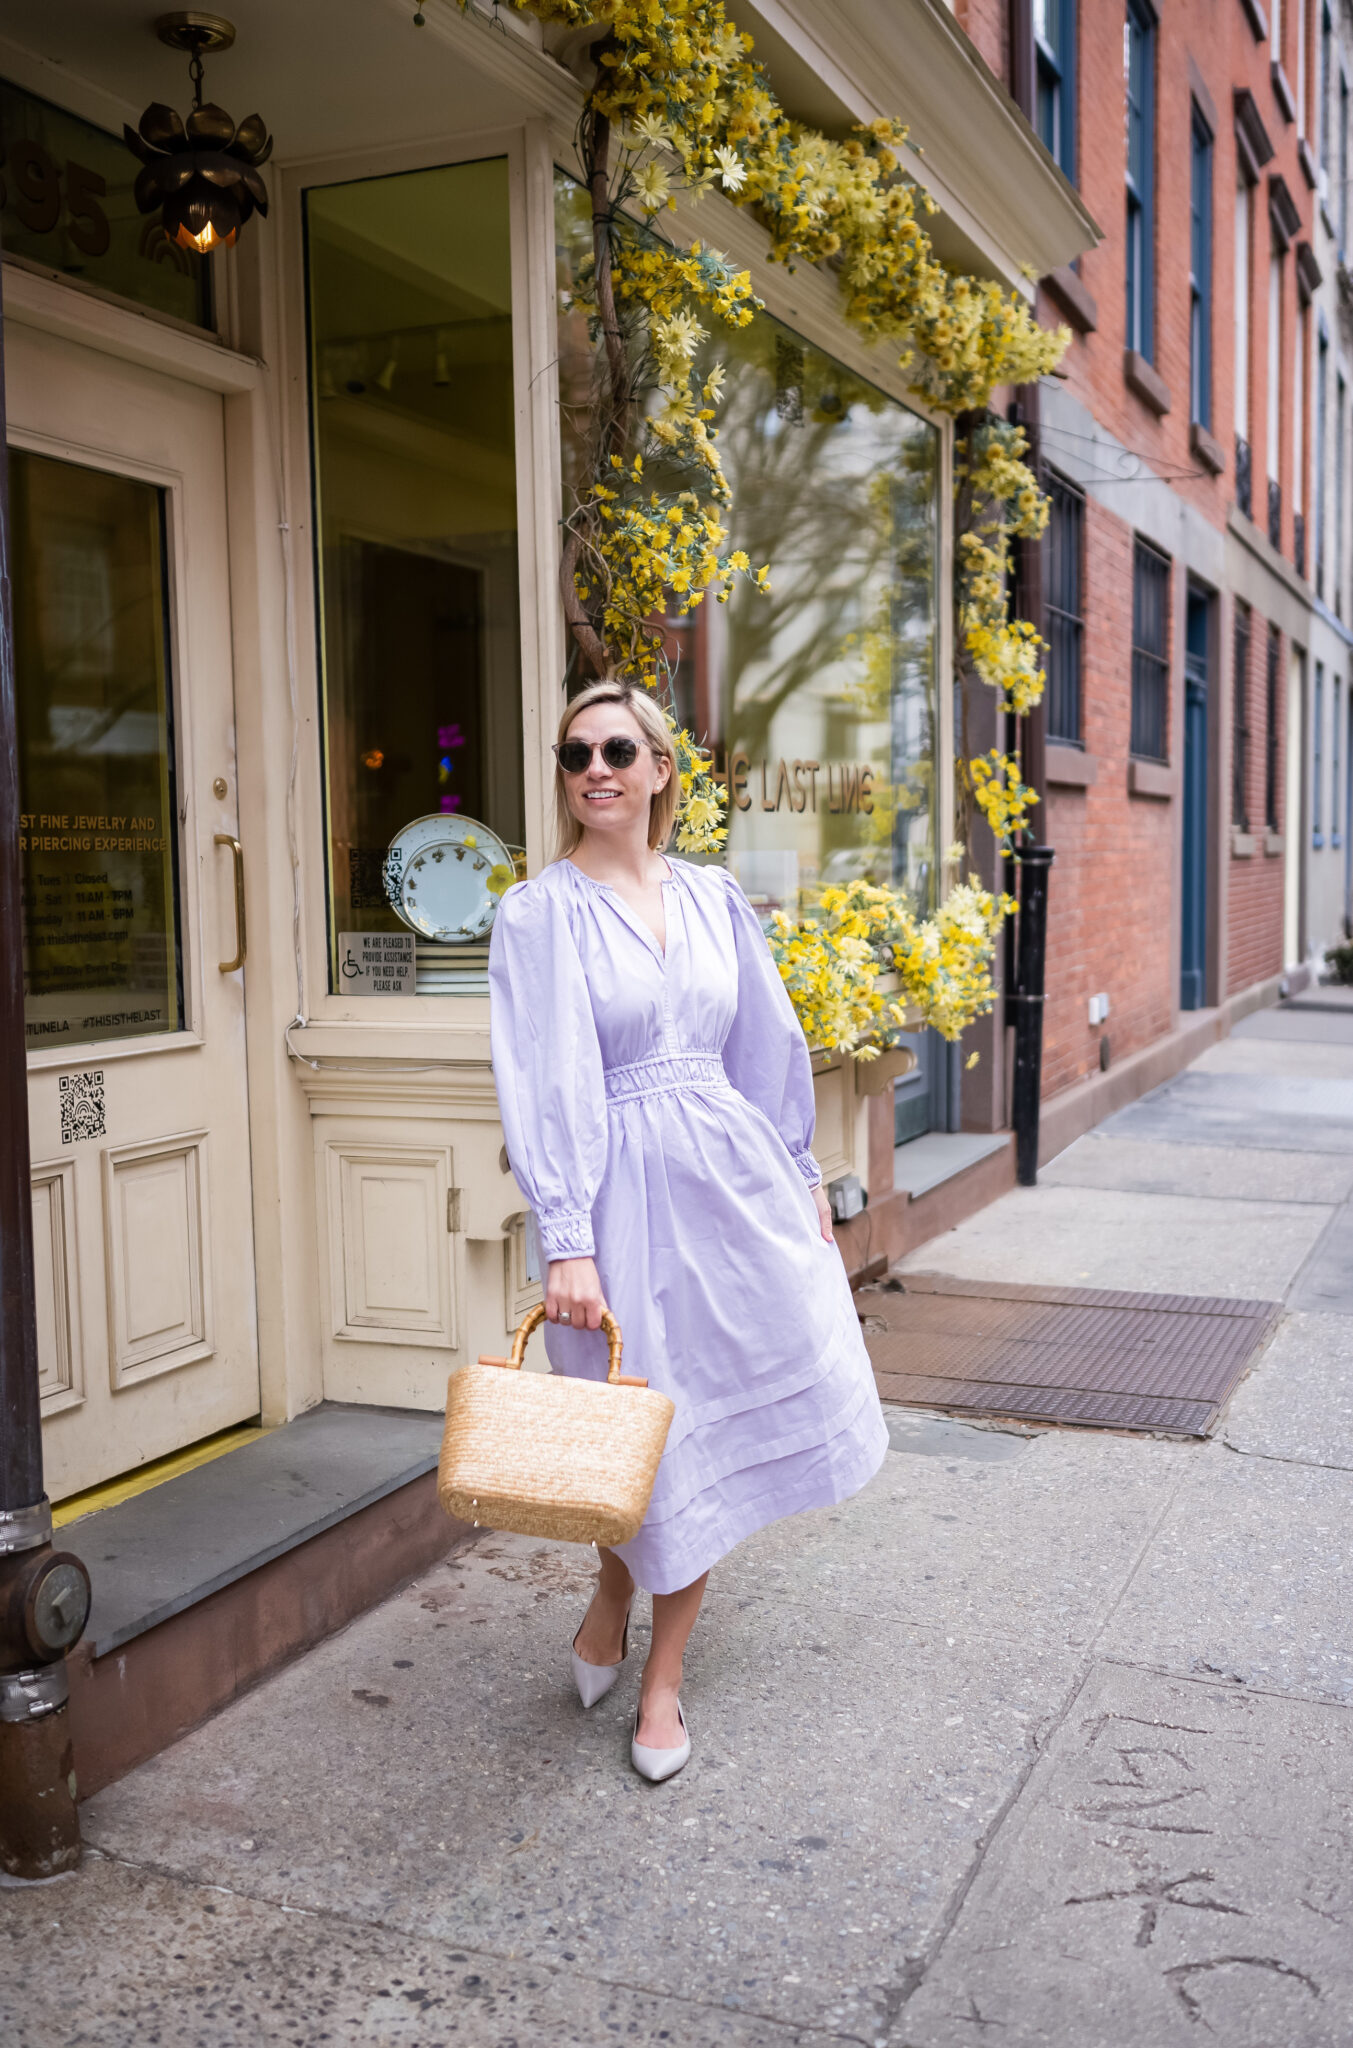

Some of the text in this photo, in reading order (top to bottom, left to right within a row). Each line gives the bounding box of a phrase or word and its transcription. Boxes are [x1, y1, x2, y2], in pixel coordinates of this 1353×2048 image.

[0, 137, 110, 257] 95
[701, 750, 752, 812] HE
[761, 757, 820, 813] LAST
[40, 814, 69, 829] FINE
[72, 815, 127, 830] JEWELRY
[130, 817, 156, 831] AND
[31, 836, 91, 851] PIERCING
[95, 837, 167, 852] EXPERIENCE
[74, 872, 108, 884] Closed
[363, 937, 411, 948] WE ARE PLEASED TO
[363, 951, 412, 963] PROVIDE ASSISTANCE
[372, 965, 381, 976] YOU
[383, 965, 394, 977] NEED
[373, 980, 402, 991] PLEASE ASK
